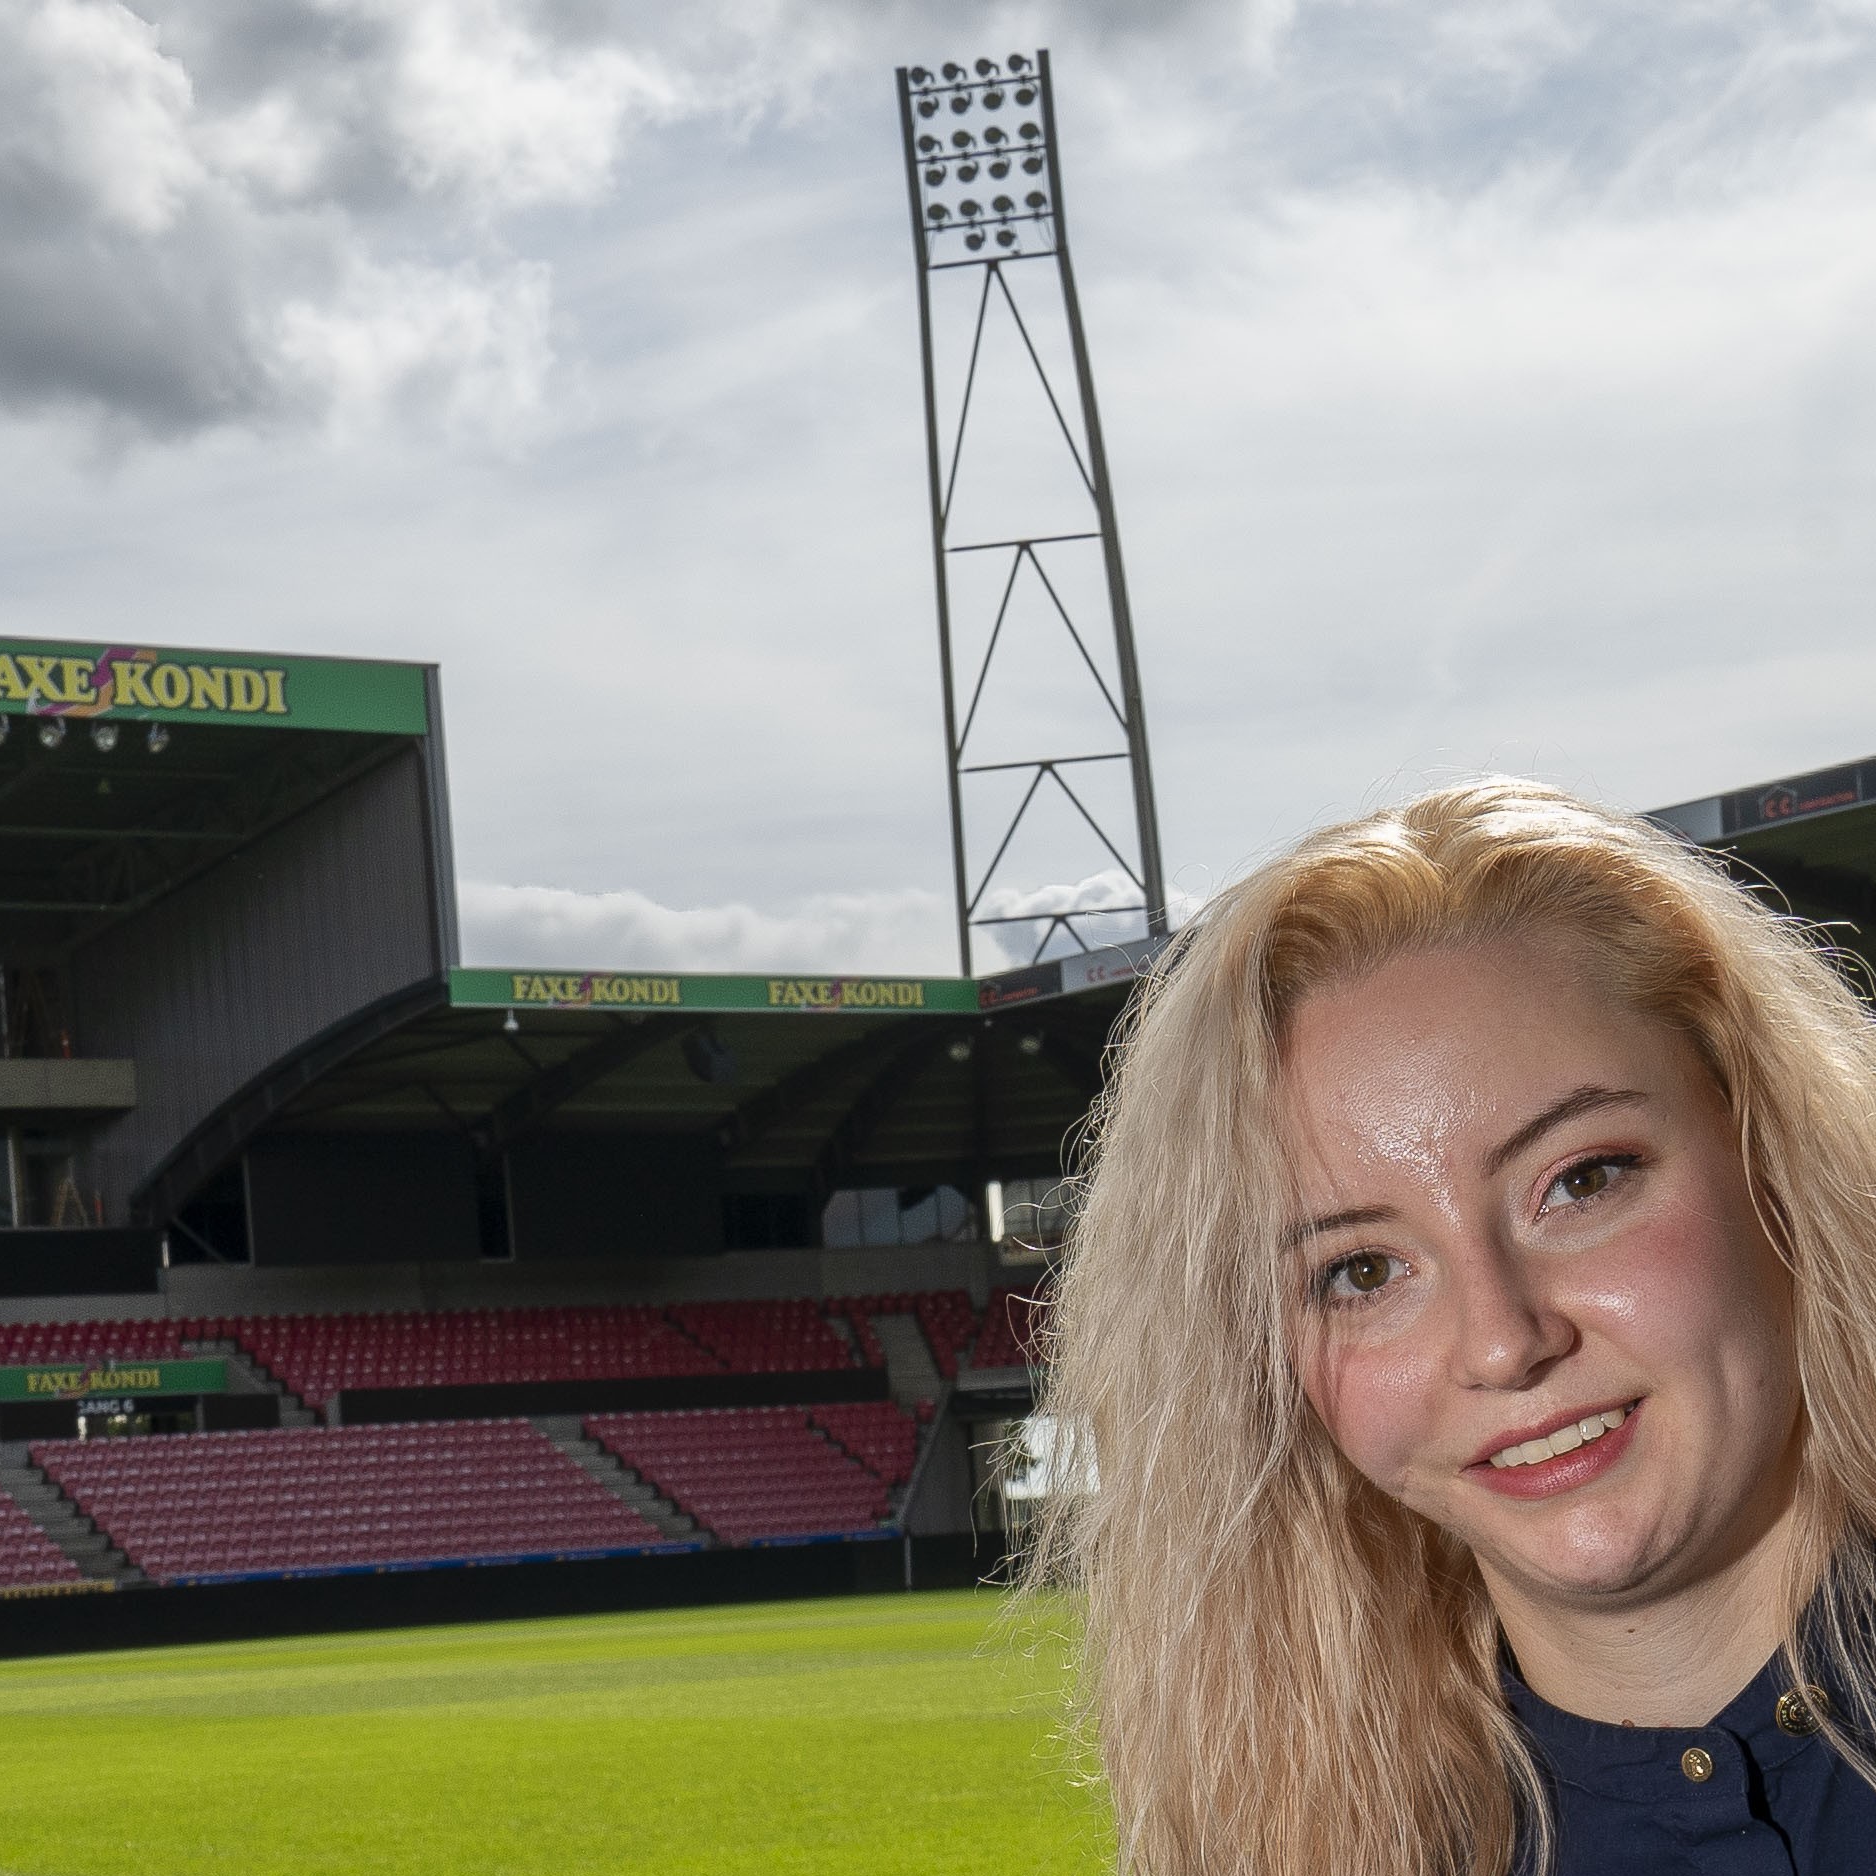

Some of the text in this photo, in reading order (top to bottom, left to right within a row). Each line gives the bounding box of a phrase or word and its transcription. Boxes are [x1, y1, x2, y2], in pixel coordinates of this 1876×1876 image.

[110, 660, 288, 715] KONDI
[511, 974, 681, 1004] FAXE KONDI
[767, 980, 925, 1007] FAXE KONDI
[26, 1368, 161, 1393] FAXE KONDI
